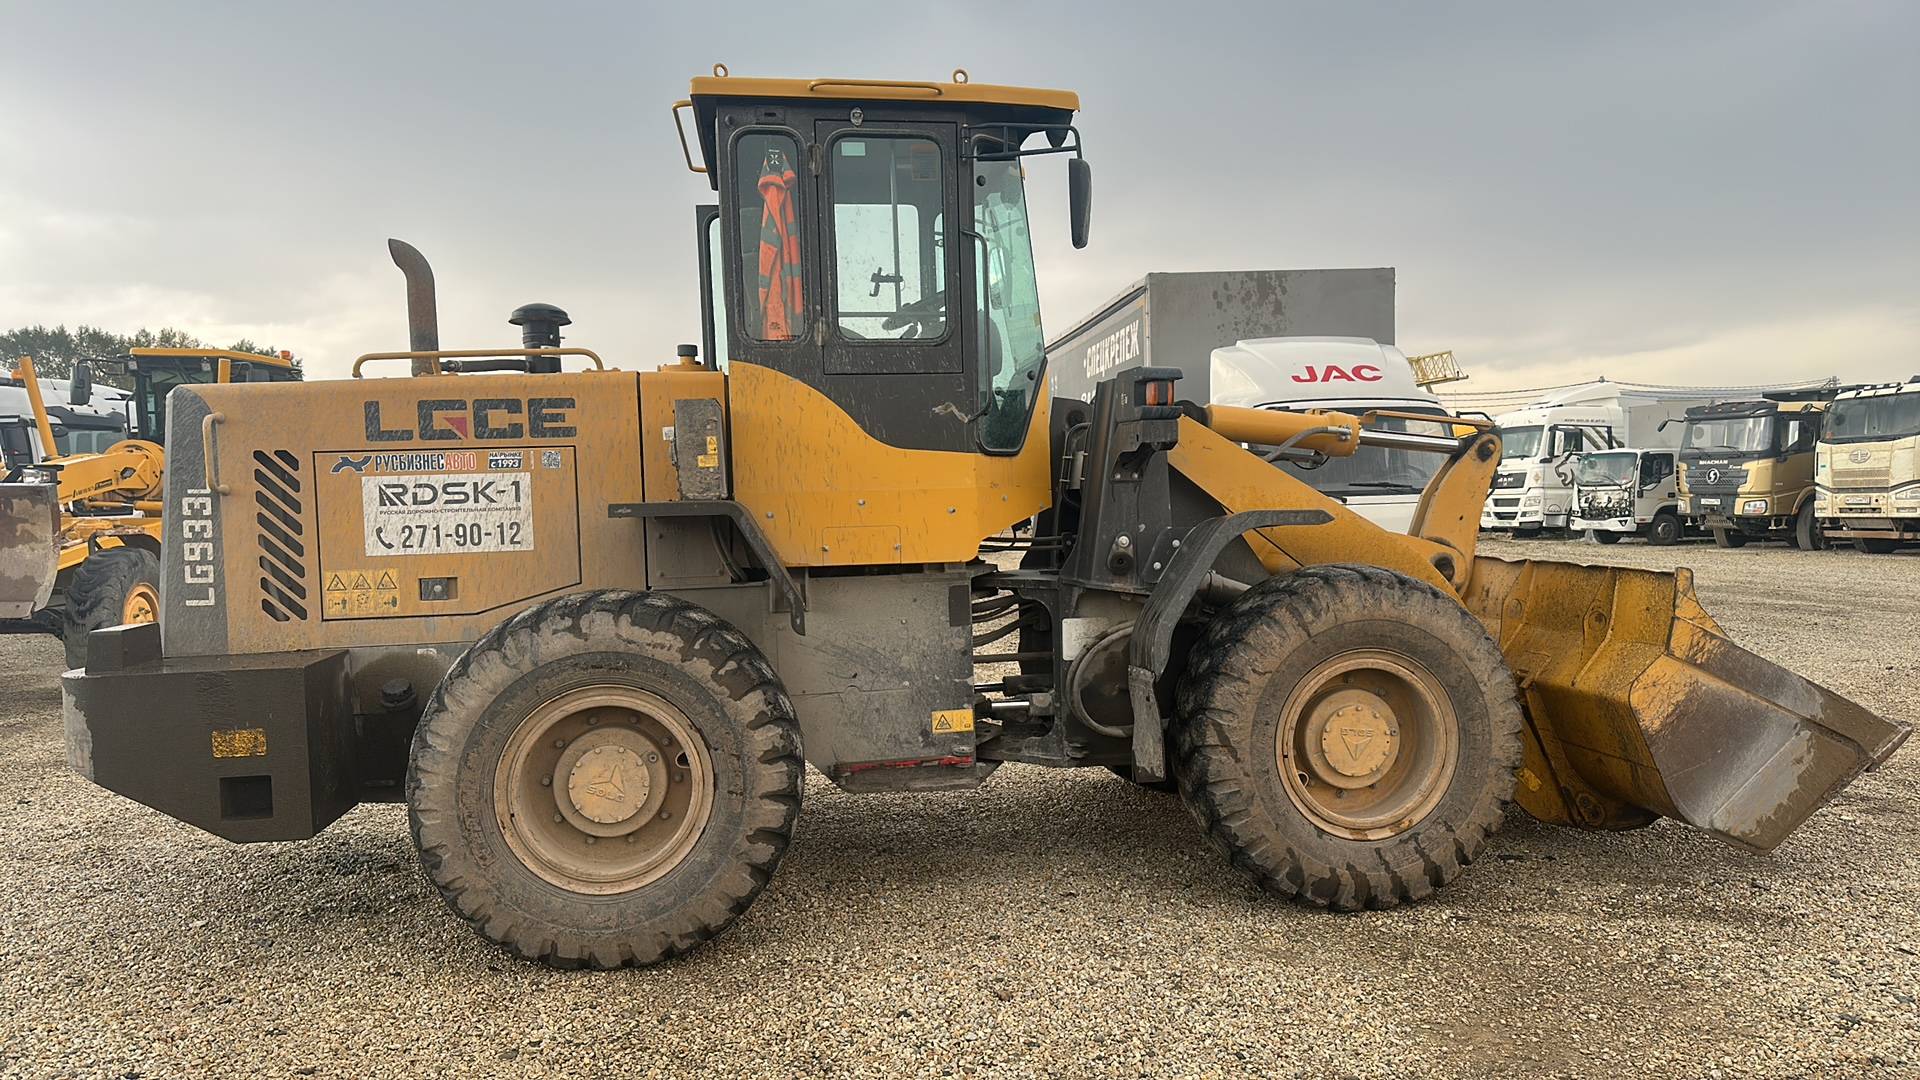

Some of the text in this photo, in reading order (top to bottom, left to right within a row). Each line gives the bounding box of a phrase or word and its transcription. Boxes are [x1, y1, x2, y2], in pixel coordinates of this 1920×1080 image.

[1291, 364, 1384, 383] JAC
[364, 397, 577, 442] LGCE
[374, 452, 477, 472] РУСБИЗНЕСАВТО
[378, 480, 521, 507] RDSK-1
[401, 521, 521, 549] 271-90-12
